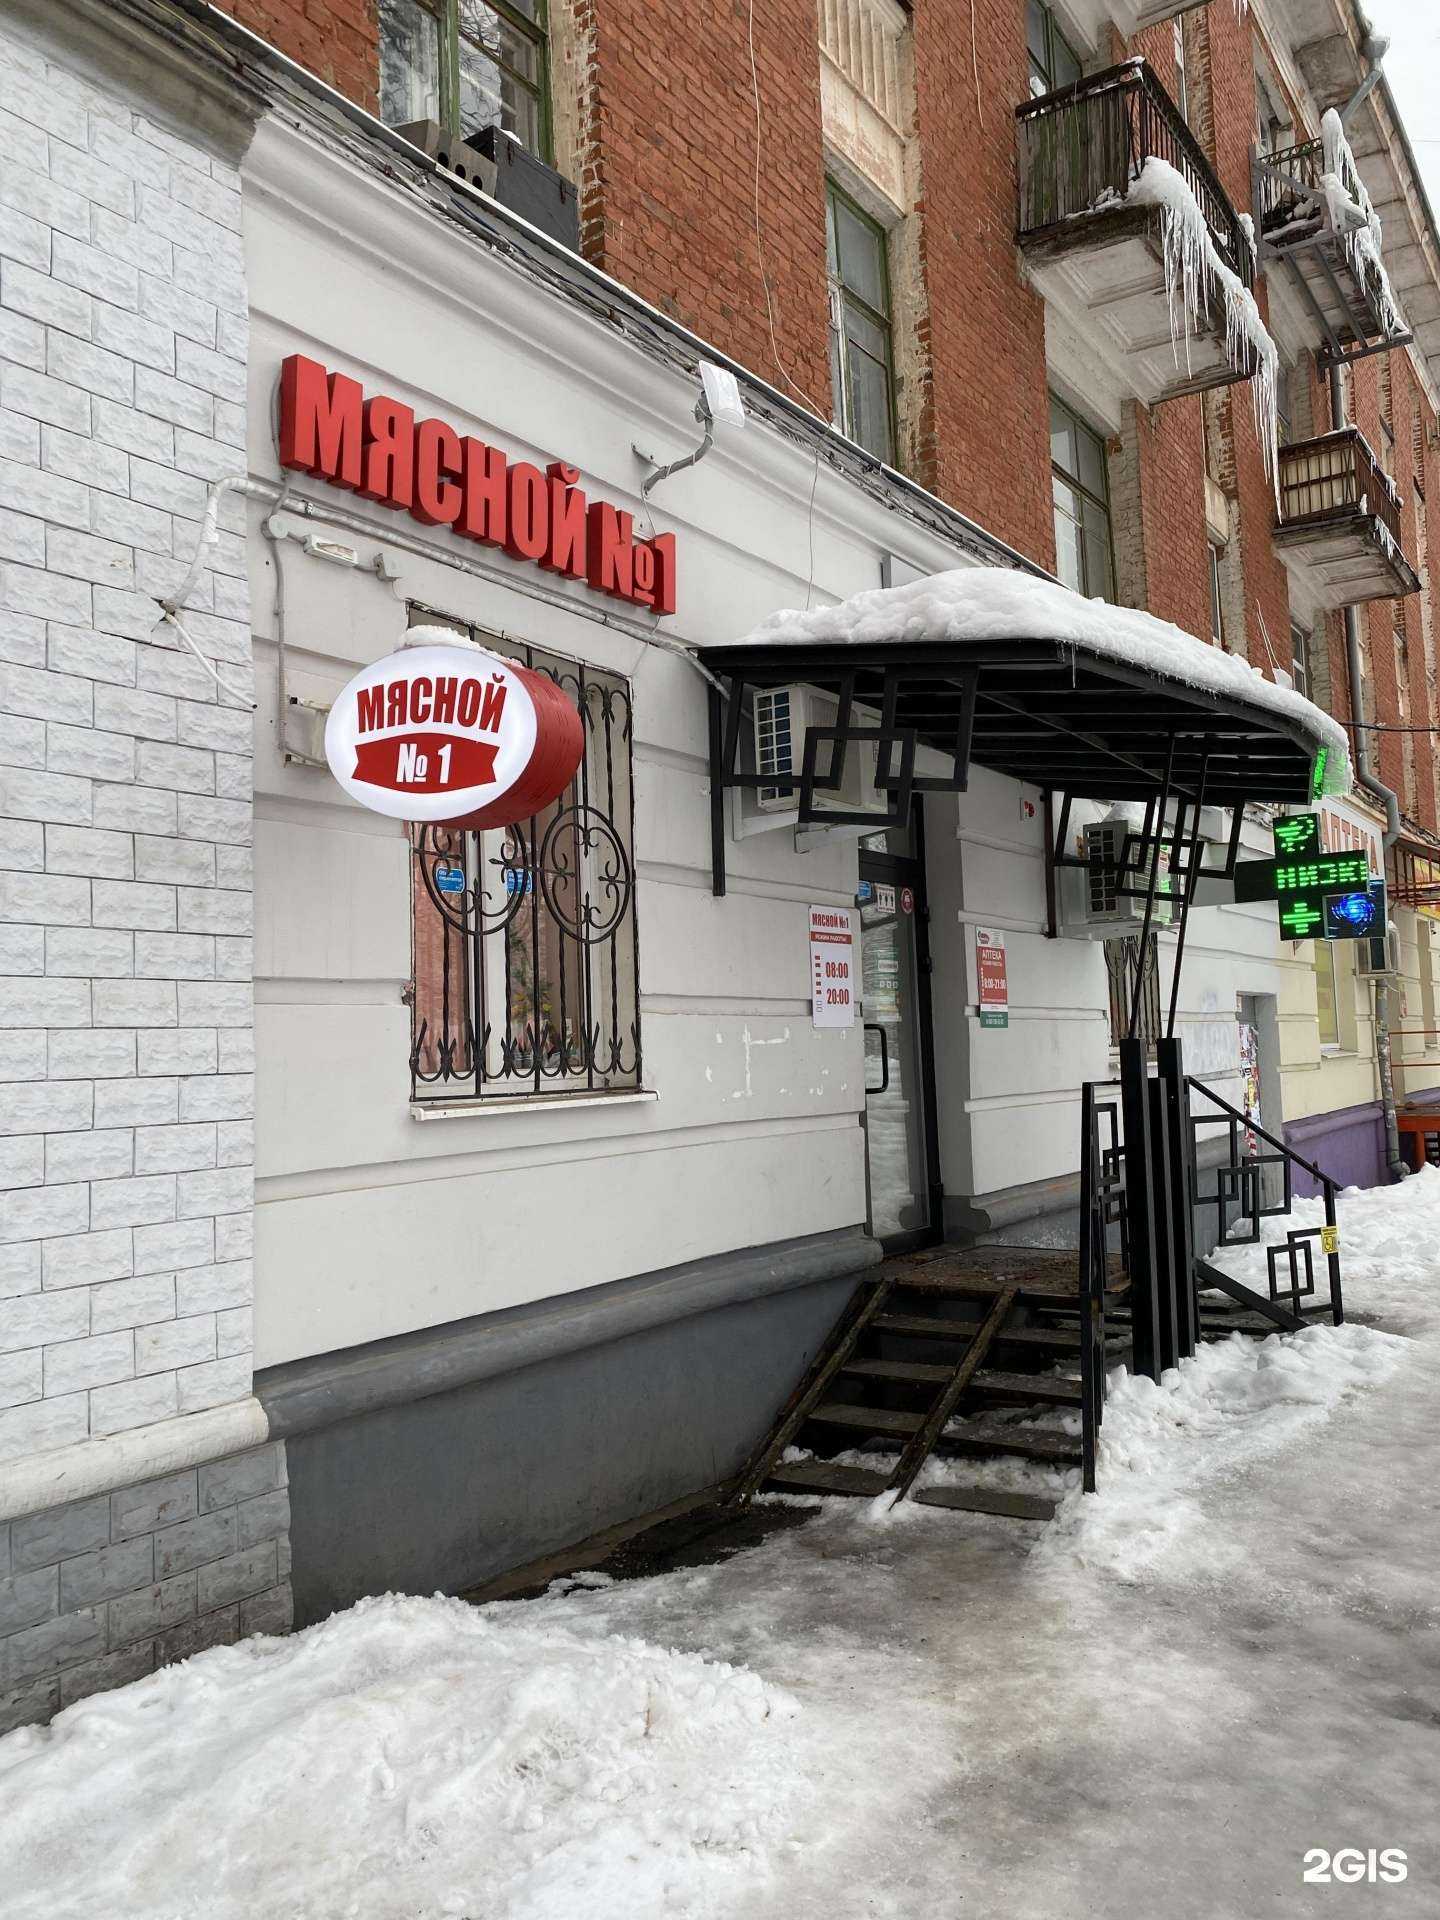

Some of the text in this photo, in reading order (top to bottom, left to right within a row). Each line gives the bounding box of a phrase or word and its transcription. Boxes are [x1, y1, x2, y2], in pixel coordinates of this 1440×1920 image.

[282, 354, 677, 616] МЯСНОЙ №1
[356, 673, 508, 734] МЯСНОЙ
[812, 912, 849, 929] МЯСНОЙ №1
[982, 949, 1002, 961] АПТЕКА
[825, 962, 849, 979] 08:00
[827, 988, 850, 1005] 20:00
